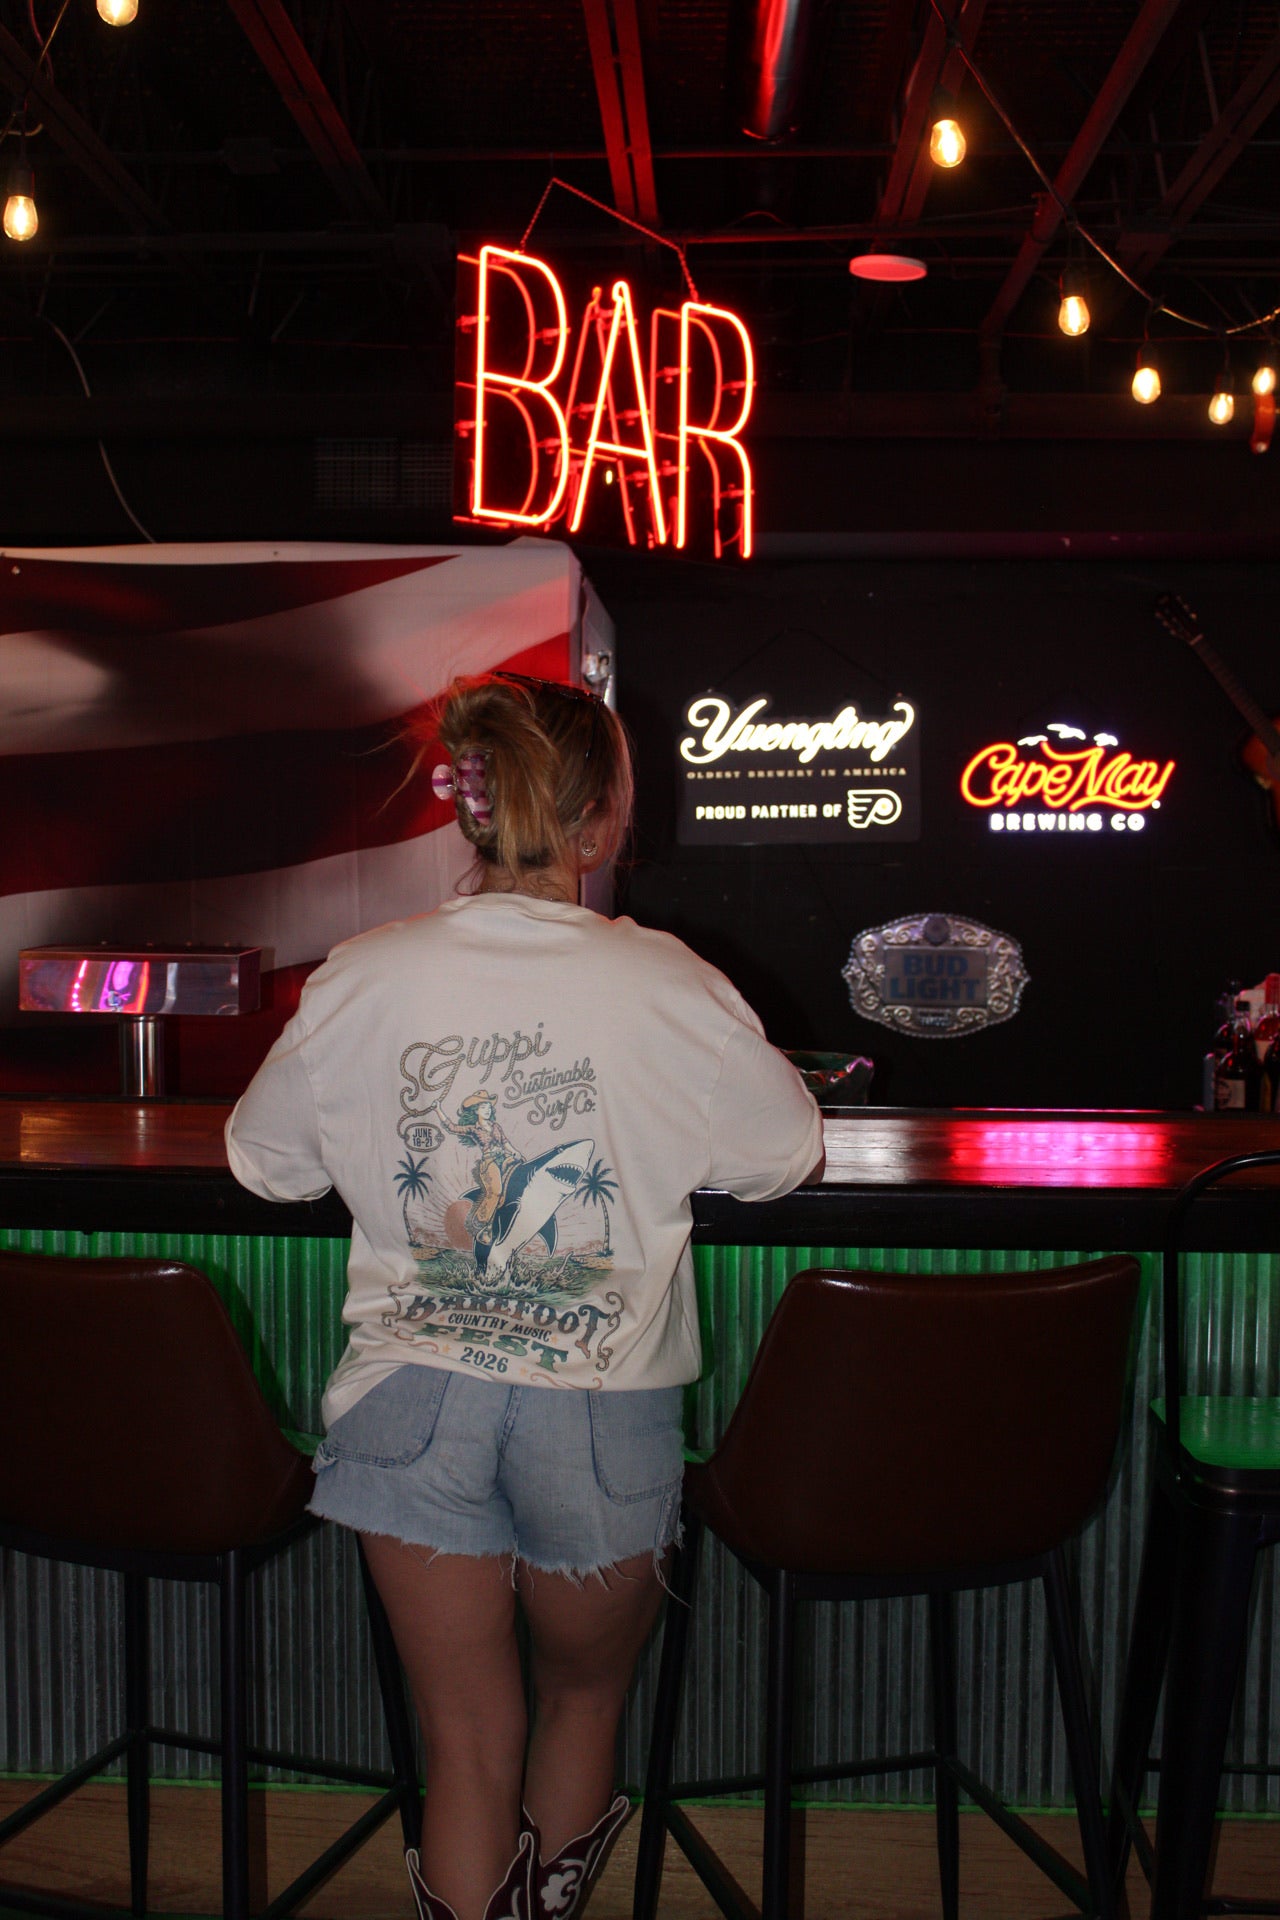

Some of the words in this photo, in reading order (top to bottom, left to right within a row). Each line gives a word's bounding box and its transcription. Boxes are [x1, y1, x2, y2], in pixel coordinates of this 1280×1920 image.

[471, 244, 756, 559] BAR
[680, 698, 915, 764] Yuengling
[686, 771, 741, 780] OLDEST
[748, 769, 814, 779] BREWERY
[821, 769, 837, 777] IN
[843, 767, 908, 777] AMERICA
[960, 743, 1072, 808] Cape
[1042, 743, 1174, 812] May
[696, 806, 746, 820] PROUD
[751, 804, 817, 819] PARTNER
[822, 803, 843, 818] OF
[989, 813, 1103, 831] BREWING
[1110, 813, 1145, 831] CO
[905, 955, 968, 976] BUD
[891, 977, 979, 998] LIGHT
[400, 1022, 552, 1102] Guppi
[505, 1057, 597, 1100] Sustainable
[527, 1093, 571, 1131] Surf
[412, 1128, 432, 1138] JUNE
[412, 1136, 433, 1147] 18-21
[448, 1312, 508, 1330] COUNTRY
[510, 1322, 552, 1343] MUSIC
[413, 1322, 568, 1374] FEST
[460, 1346, 509, 1374] 2026
